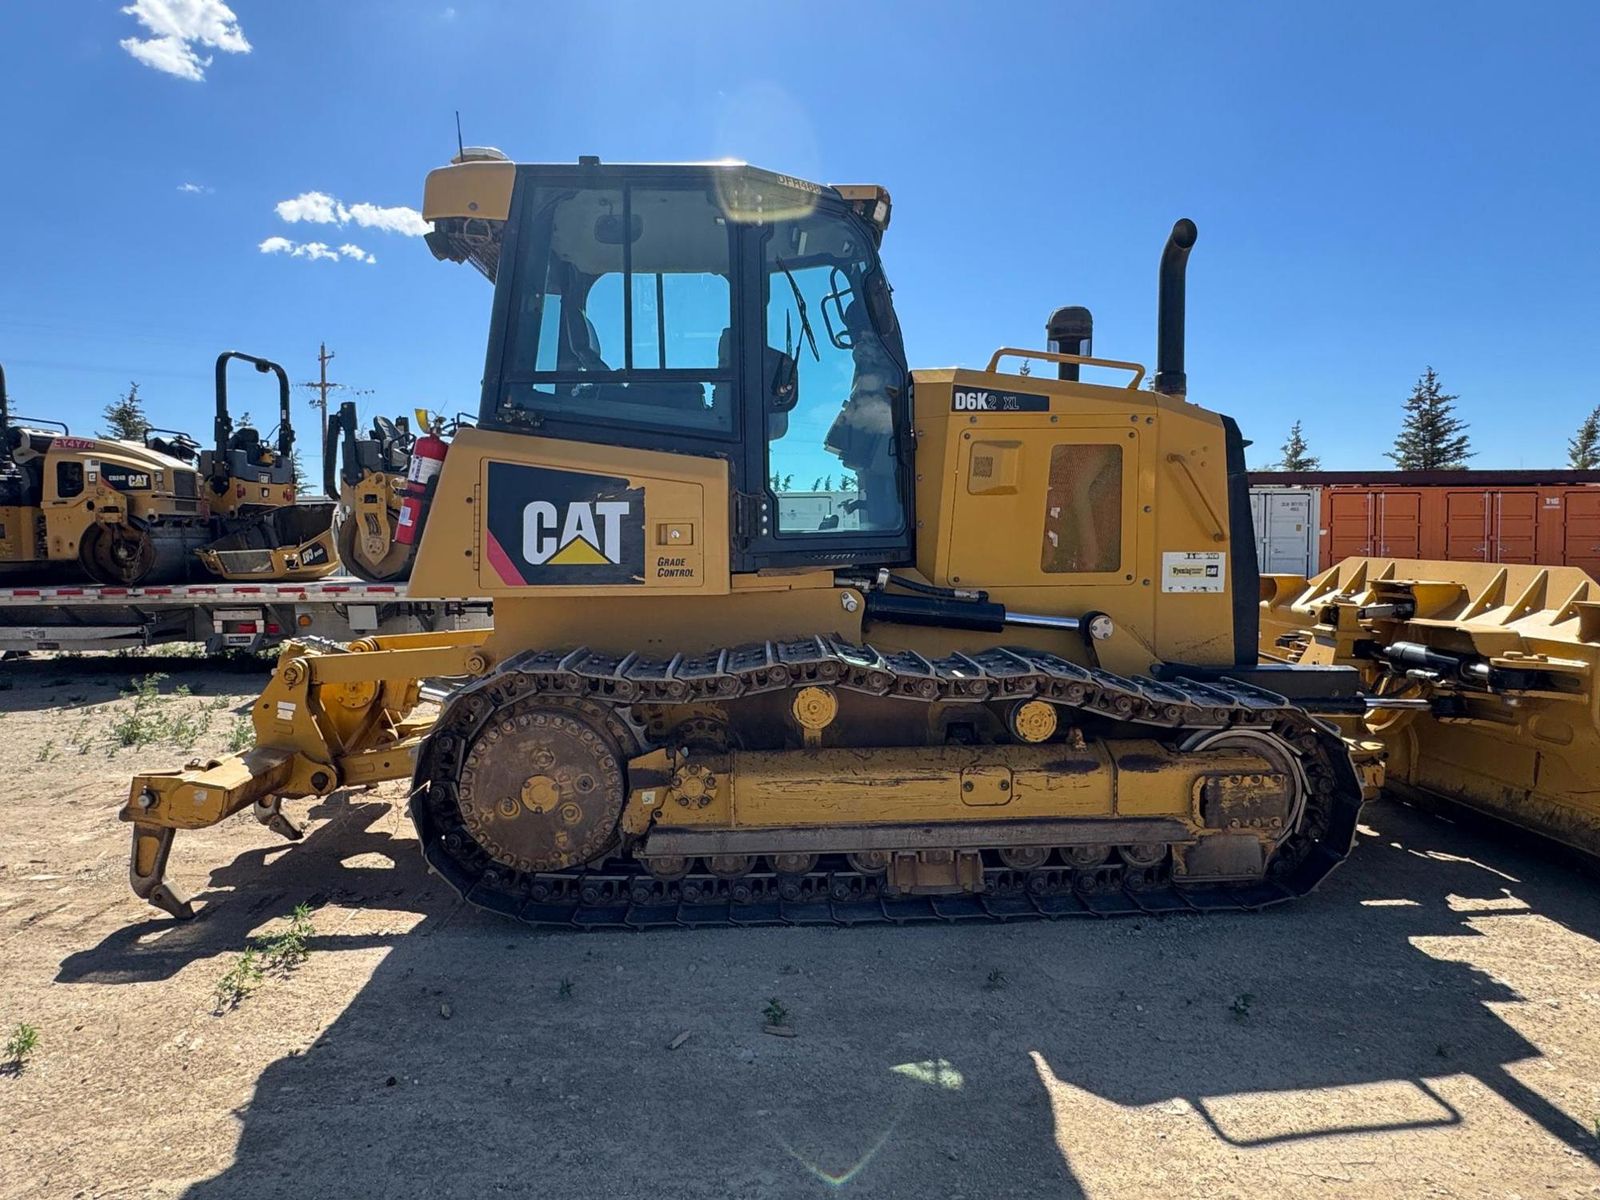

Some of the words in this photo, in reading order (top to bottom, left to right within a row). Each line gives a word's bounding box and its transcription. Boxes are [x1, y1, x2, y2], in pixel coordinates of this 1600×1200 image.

[955, 392, 997, 410] D6K2
[1003, 396, 1020, 410] XL
[128, 474, 148, 487] CAT
[522, 500, 630, 566] CAT
[657, 556, 686, 567] GRADE
[657, 567, 695, 578] CONTROL
